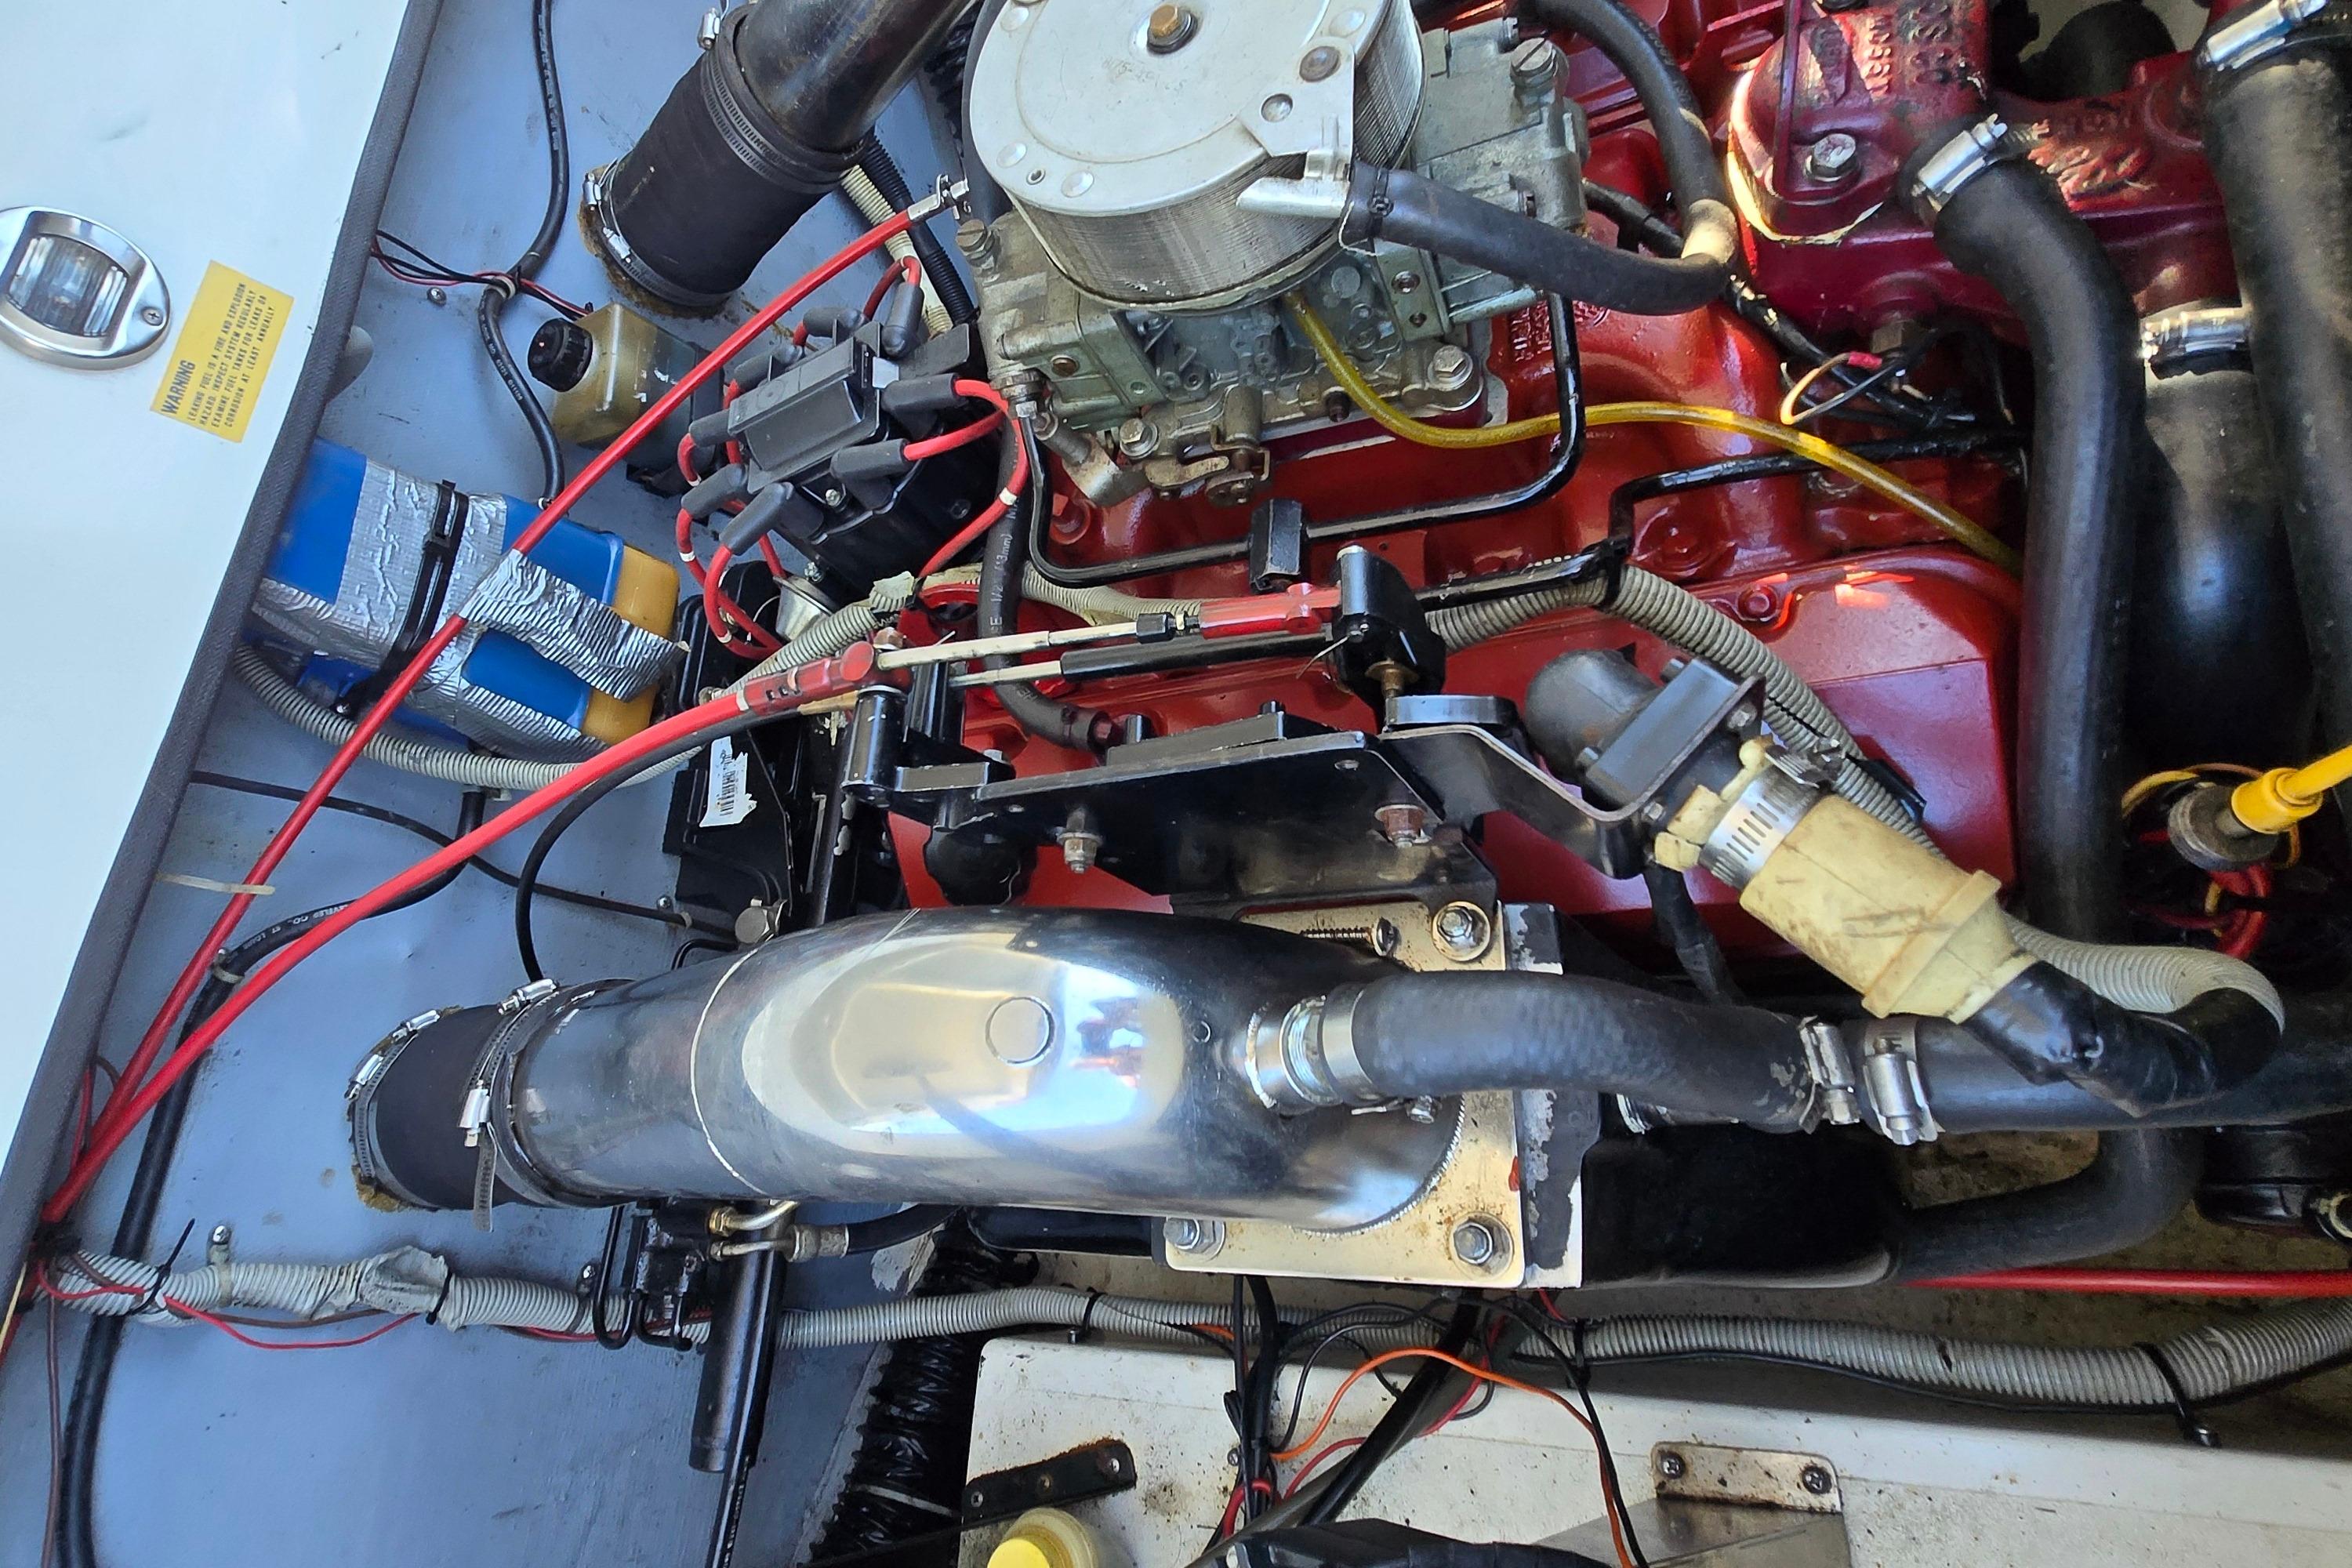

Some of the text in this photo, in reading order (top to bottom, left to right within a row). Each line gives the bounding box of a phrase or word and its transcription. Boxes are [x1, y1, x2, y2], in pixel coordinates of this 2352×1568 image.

[161, 360, 195, 414] WARNING
[187, 391, 205, 421] LEAKING
[199, 372, 213, 390] FUEL
[214, 336, 226, 352] FIRE
[221, 320, 232, 335] AND
[227, 282, 246, 319] EXPLOSION
[211, 395, 230, 427] EXAMINE
[224, 375, 238, 393] FUEL
[232, 348, 247, 371] TANKS
[241, 332, 253, 347] FOR
[249, 307, 263, 330] LEAKS
[212, 361, 228, 391] INSPECT
[224, 331, 241, 360] SYSTEM
[224, 387, 245, 427] CORROSION
[246, 346, 260, 370] LEAST
